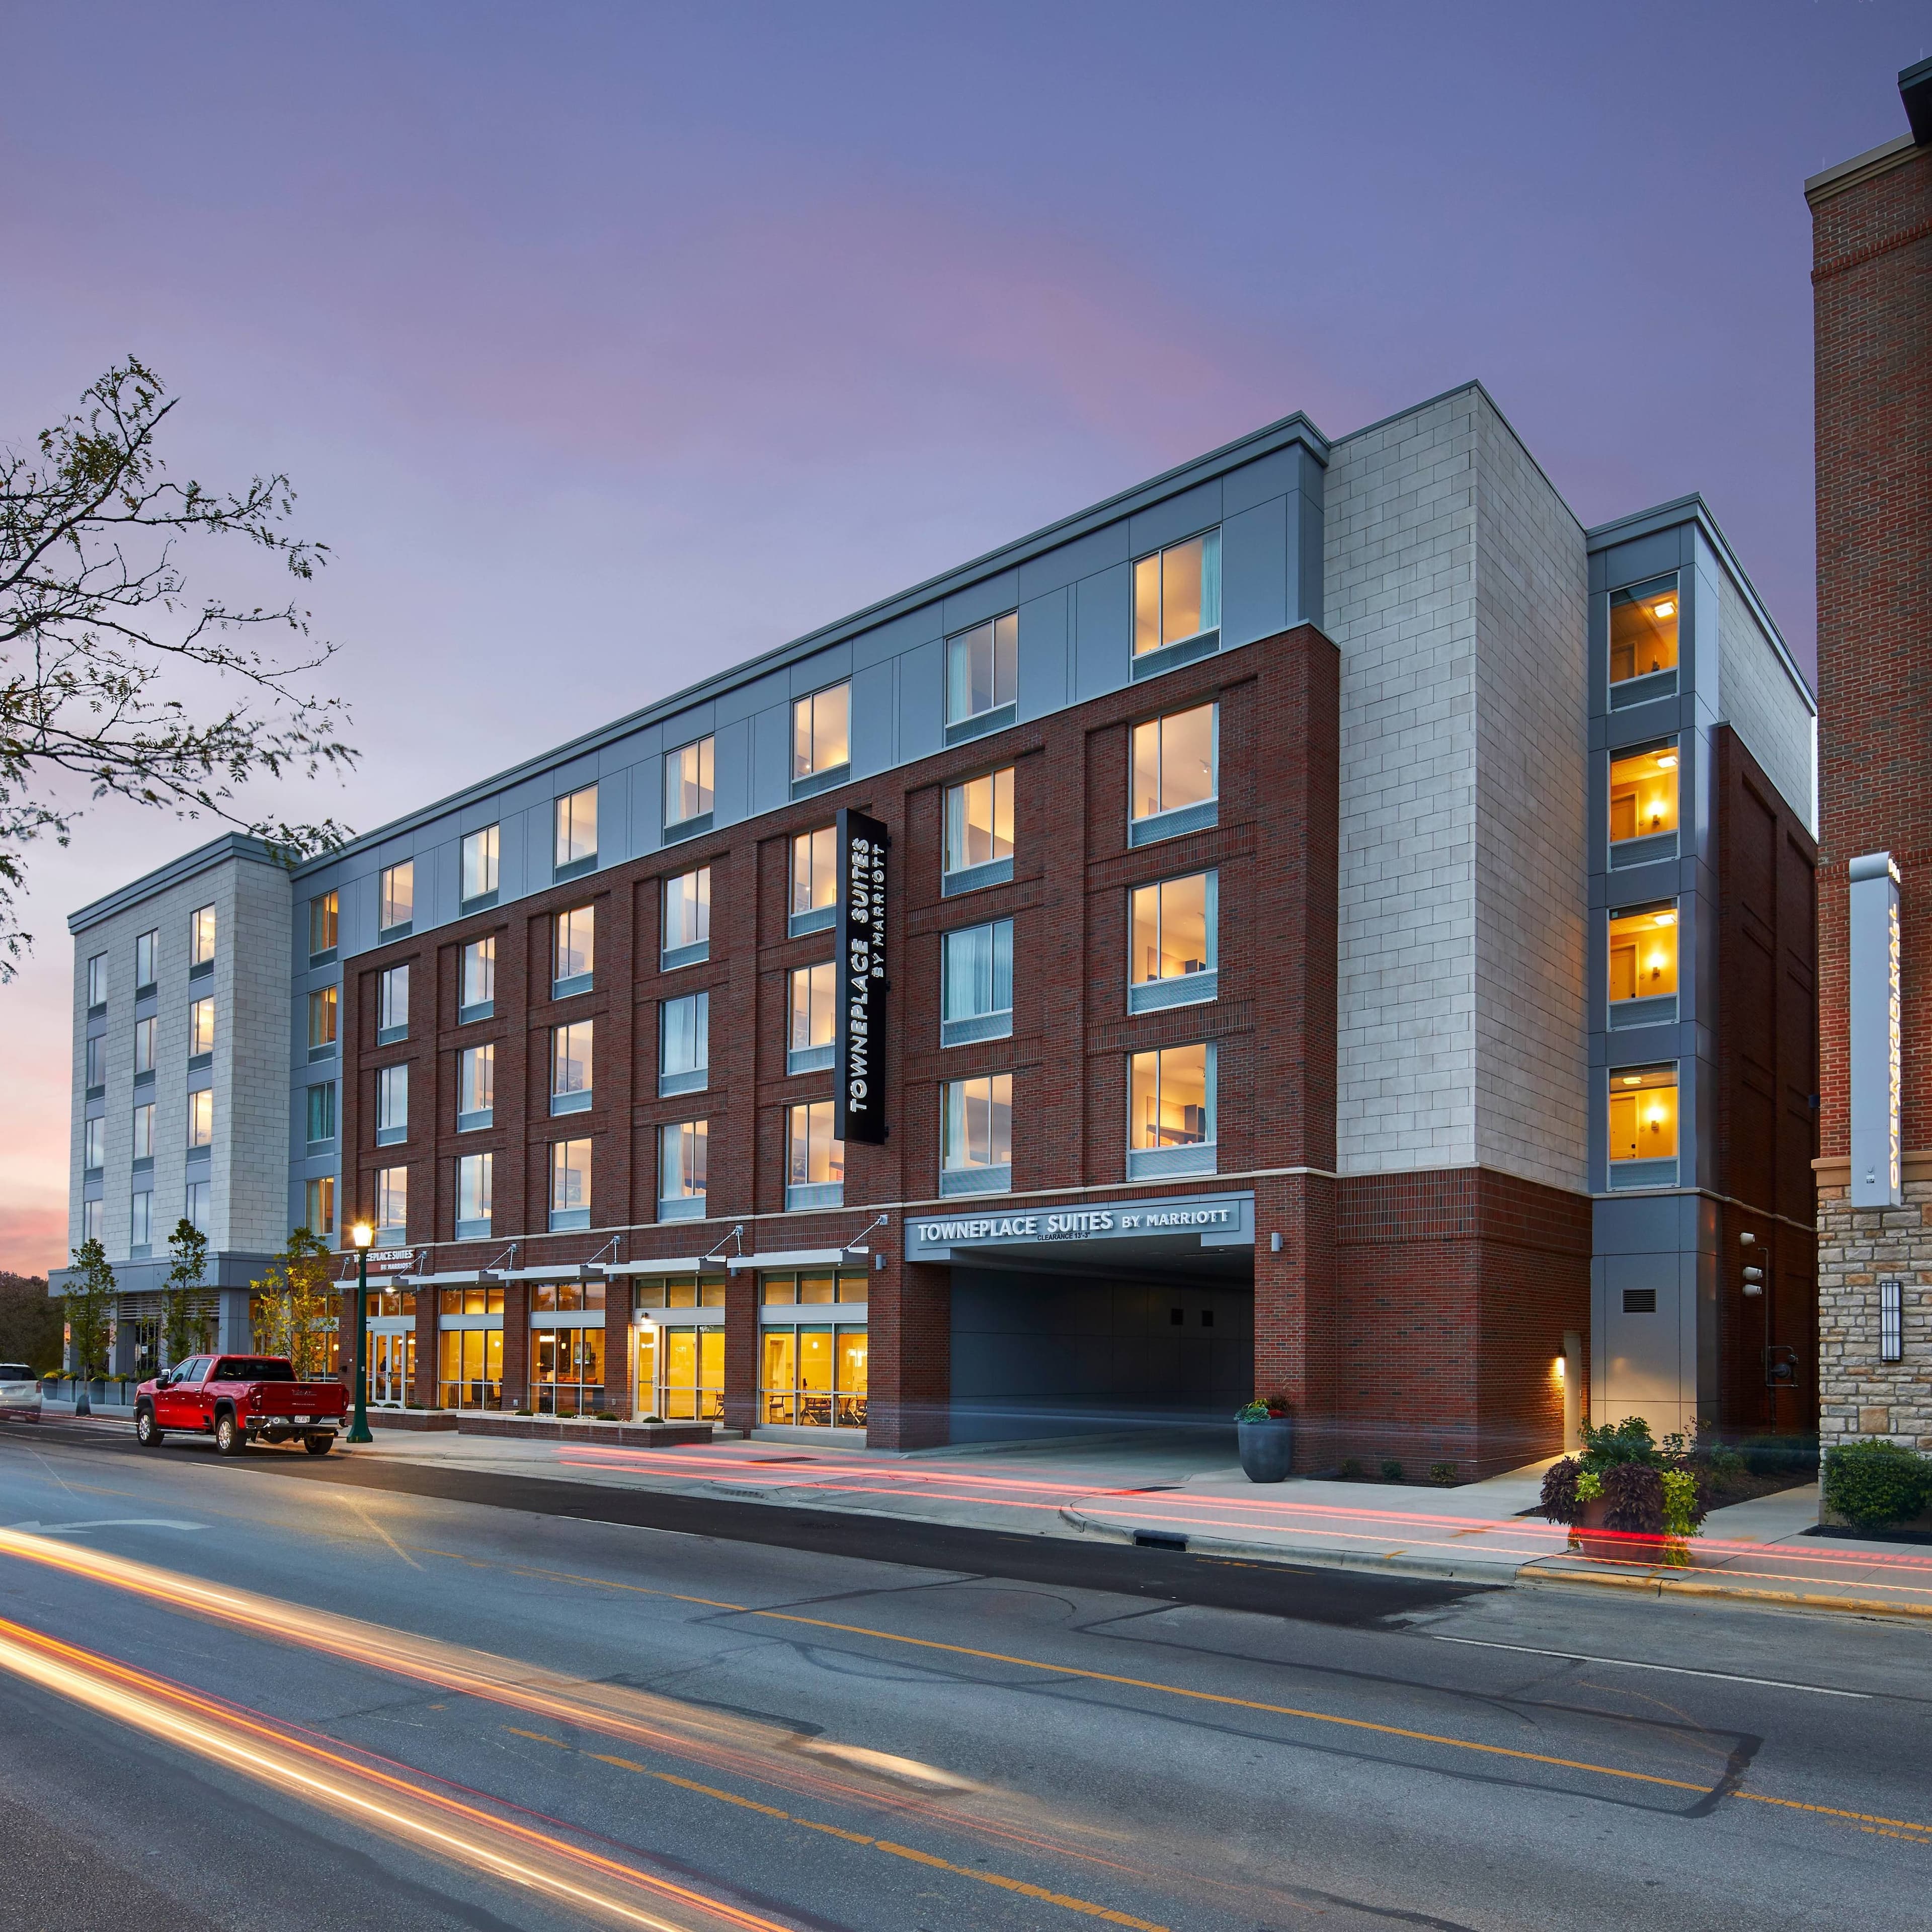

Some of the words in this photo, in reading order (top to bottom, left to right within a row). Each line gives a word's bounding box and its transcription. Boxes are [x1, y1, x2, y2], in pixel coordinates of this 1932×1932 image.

[852, 838, 869, 924] SUITES
[872, 844, 884, 946] MARRIOTT
[872, 953, 884, 978] BY
[850, 939, 868, 1112] TOWNEPLACE
[918, 1217, 1037, 1241] TOWNEPLACE
[1047, 1211, 1114, 1233] SUITES
[1122, 1215, 1142, 1228] BY
[1147, 1210, 1230, 1227] MARRIOTT
[392, 1250, 412, 1260] SUITES
